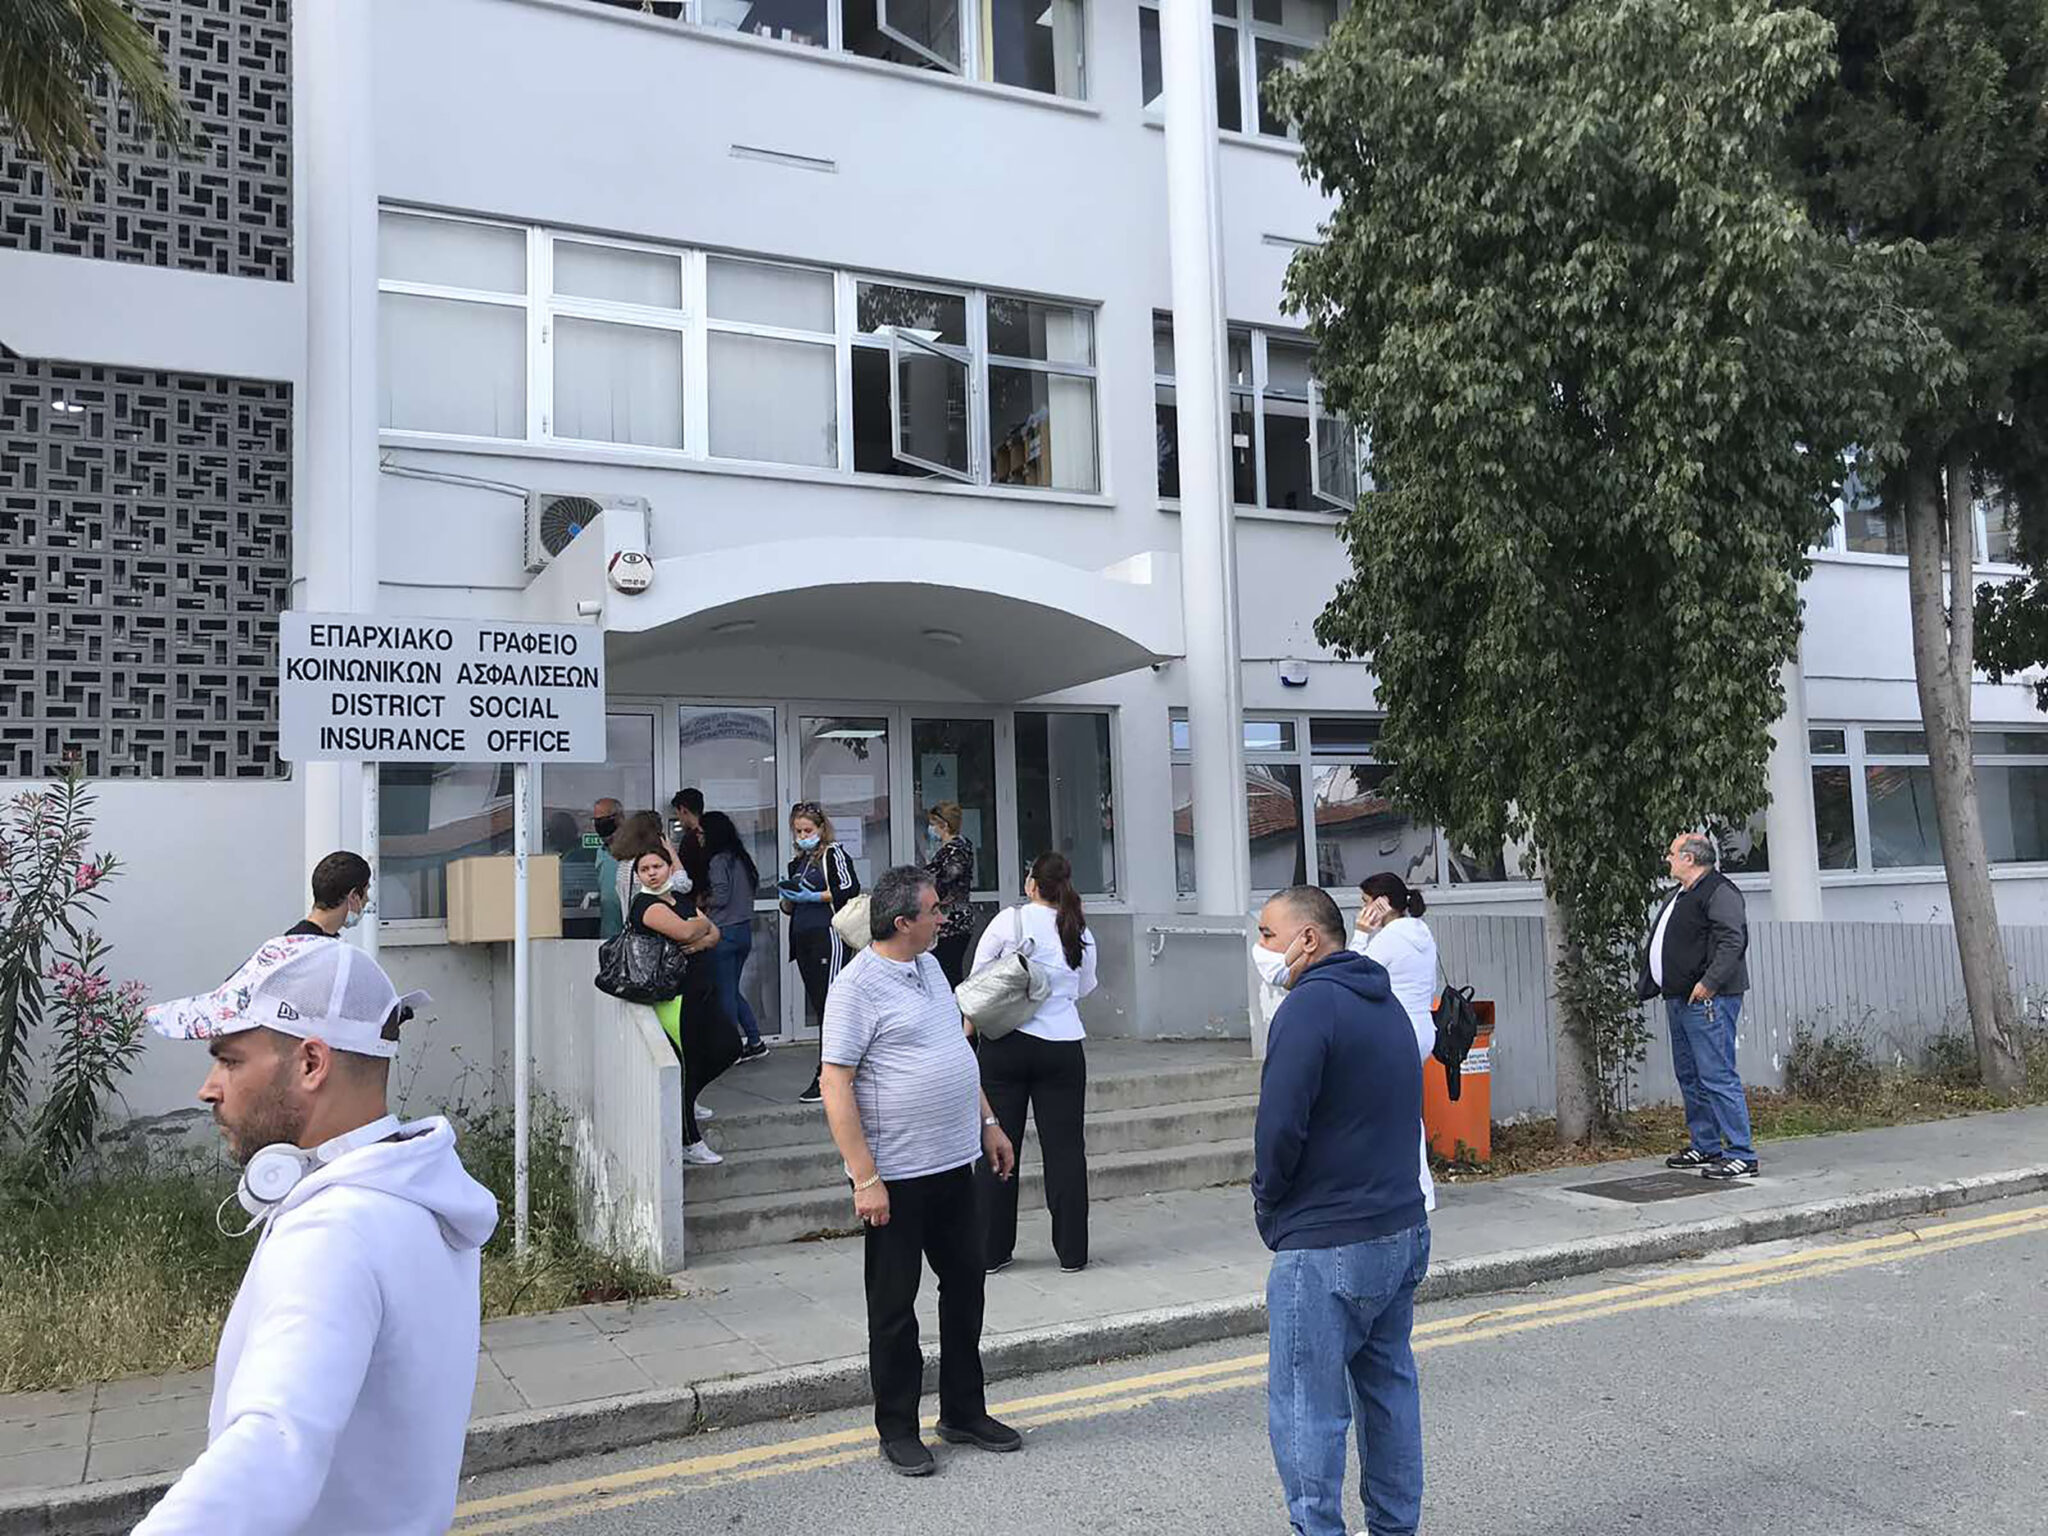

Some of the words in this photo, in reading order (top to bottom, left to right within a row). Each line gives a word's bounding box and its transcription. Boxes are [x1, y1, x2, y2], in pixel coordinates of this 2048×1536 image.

[310, 624, 453, 651] ΕΠΑΡΧΙΑΚΟ
[479, 630, 578, 656] ΓΡΑΦΕΙΟ
[286, 657, 441, 684] ΚΟΙΝΩΝΙΚΩΝ
[456, 662, 599, 689] ΑΣΦΑΛΙΣΕΩΝ
[331, 692, 446, 718] DISTRICT
[469, 695, 559, 720] SOCIAL
[320, 726, 466, 752] INSURANCE
[487, 729, 571, 753] OFFICE
